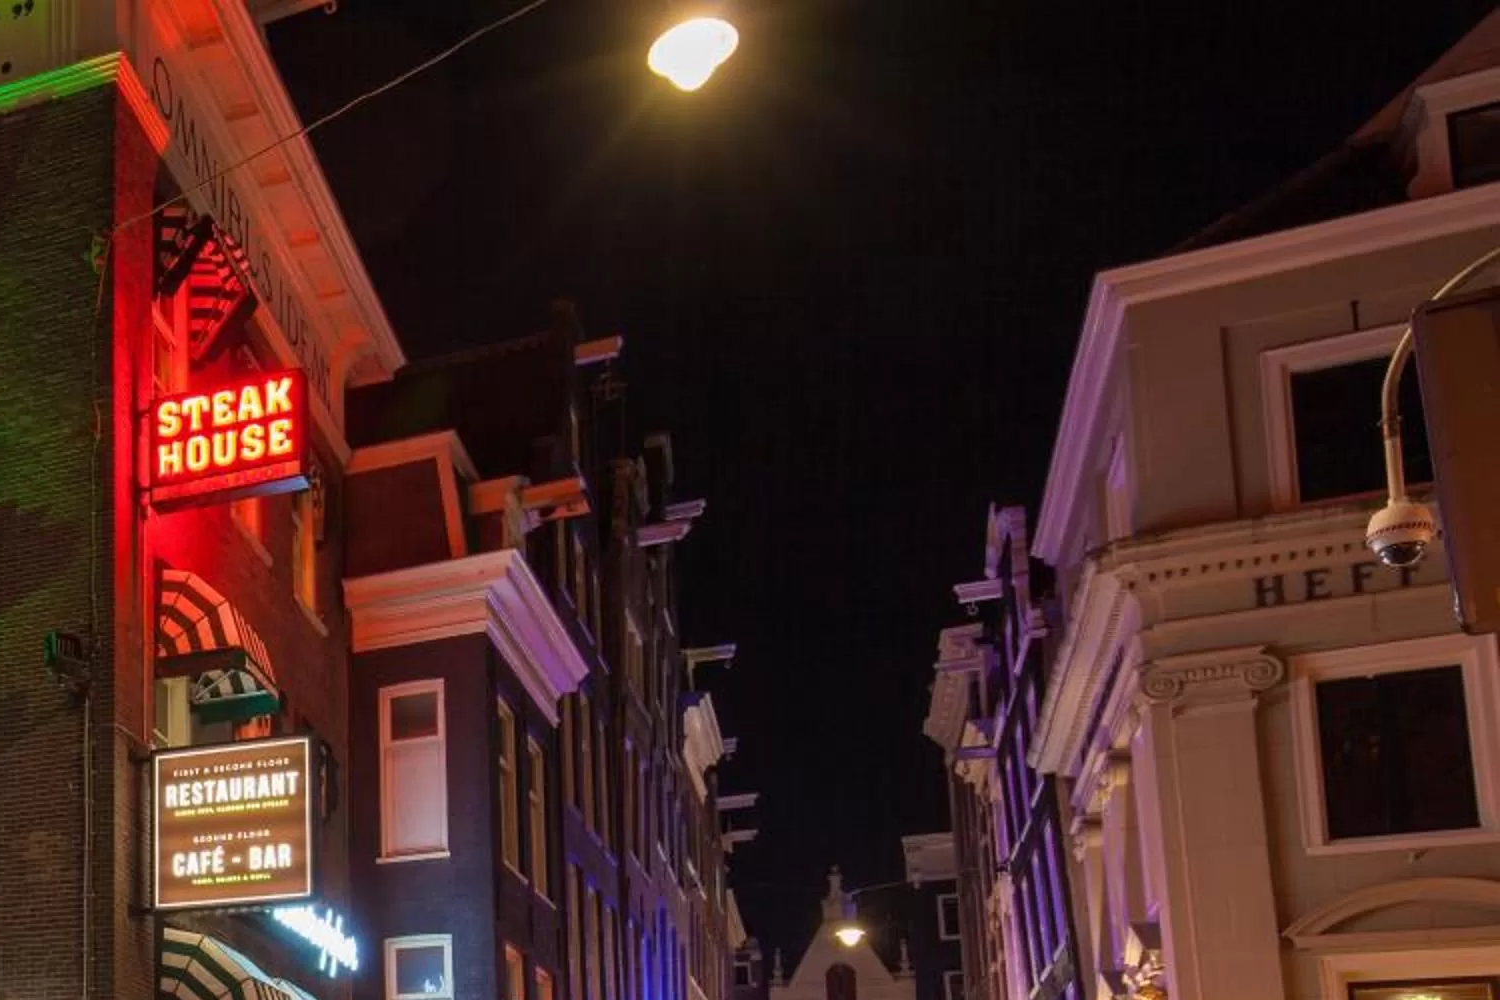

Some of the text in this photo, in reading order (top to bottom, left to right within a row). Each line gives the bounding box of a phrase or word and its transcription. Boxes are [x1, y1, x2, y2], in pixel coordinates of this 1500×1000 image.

[158, 377, 293, 437] STEAK
[158, 419, 293, 477] HOUSE
[165, 771, 299, 808] RESTAURANT
[172, 845, 225, 877] CAFÉ
[248, 843, 292, 870] BAR
